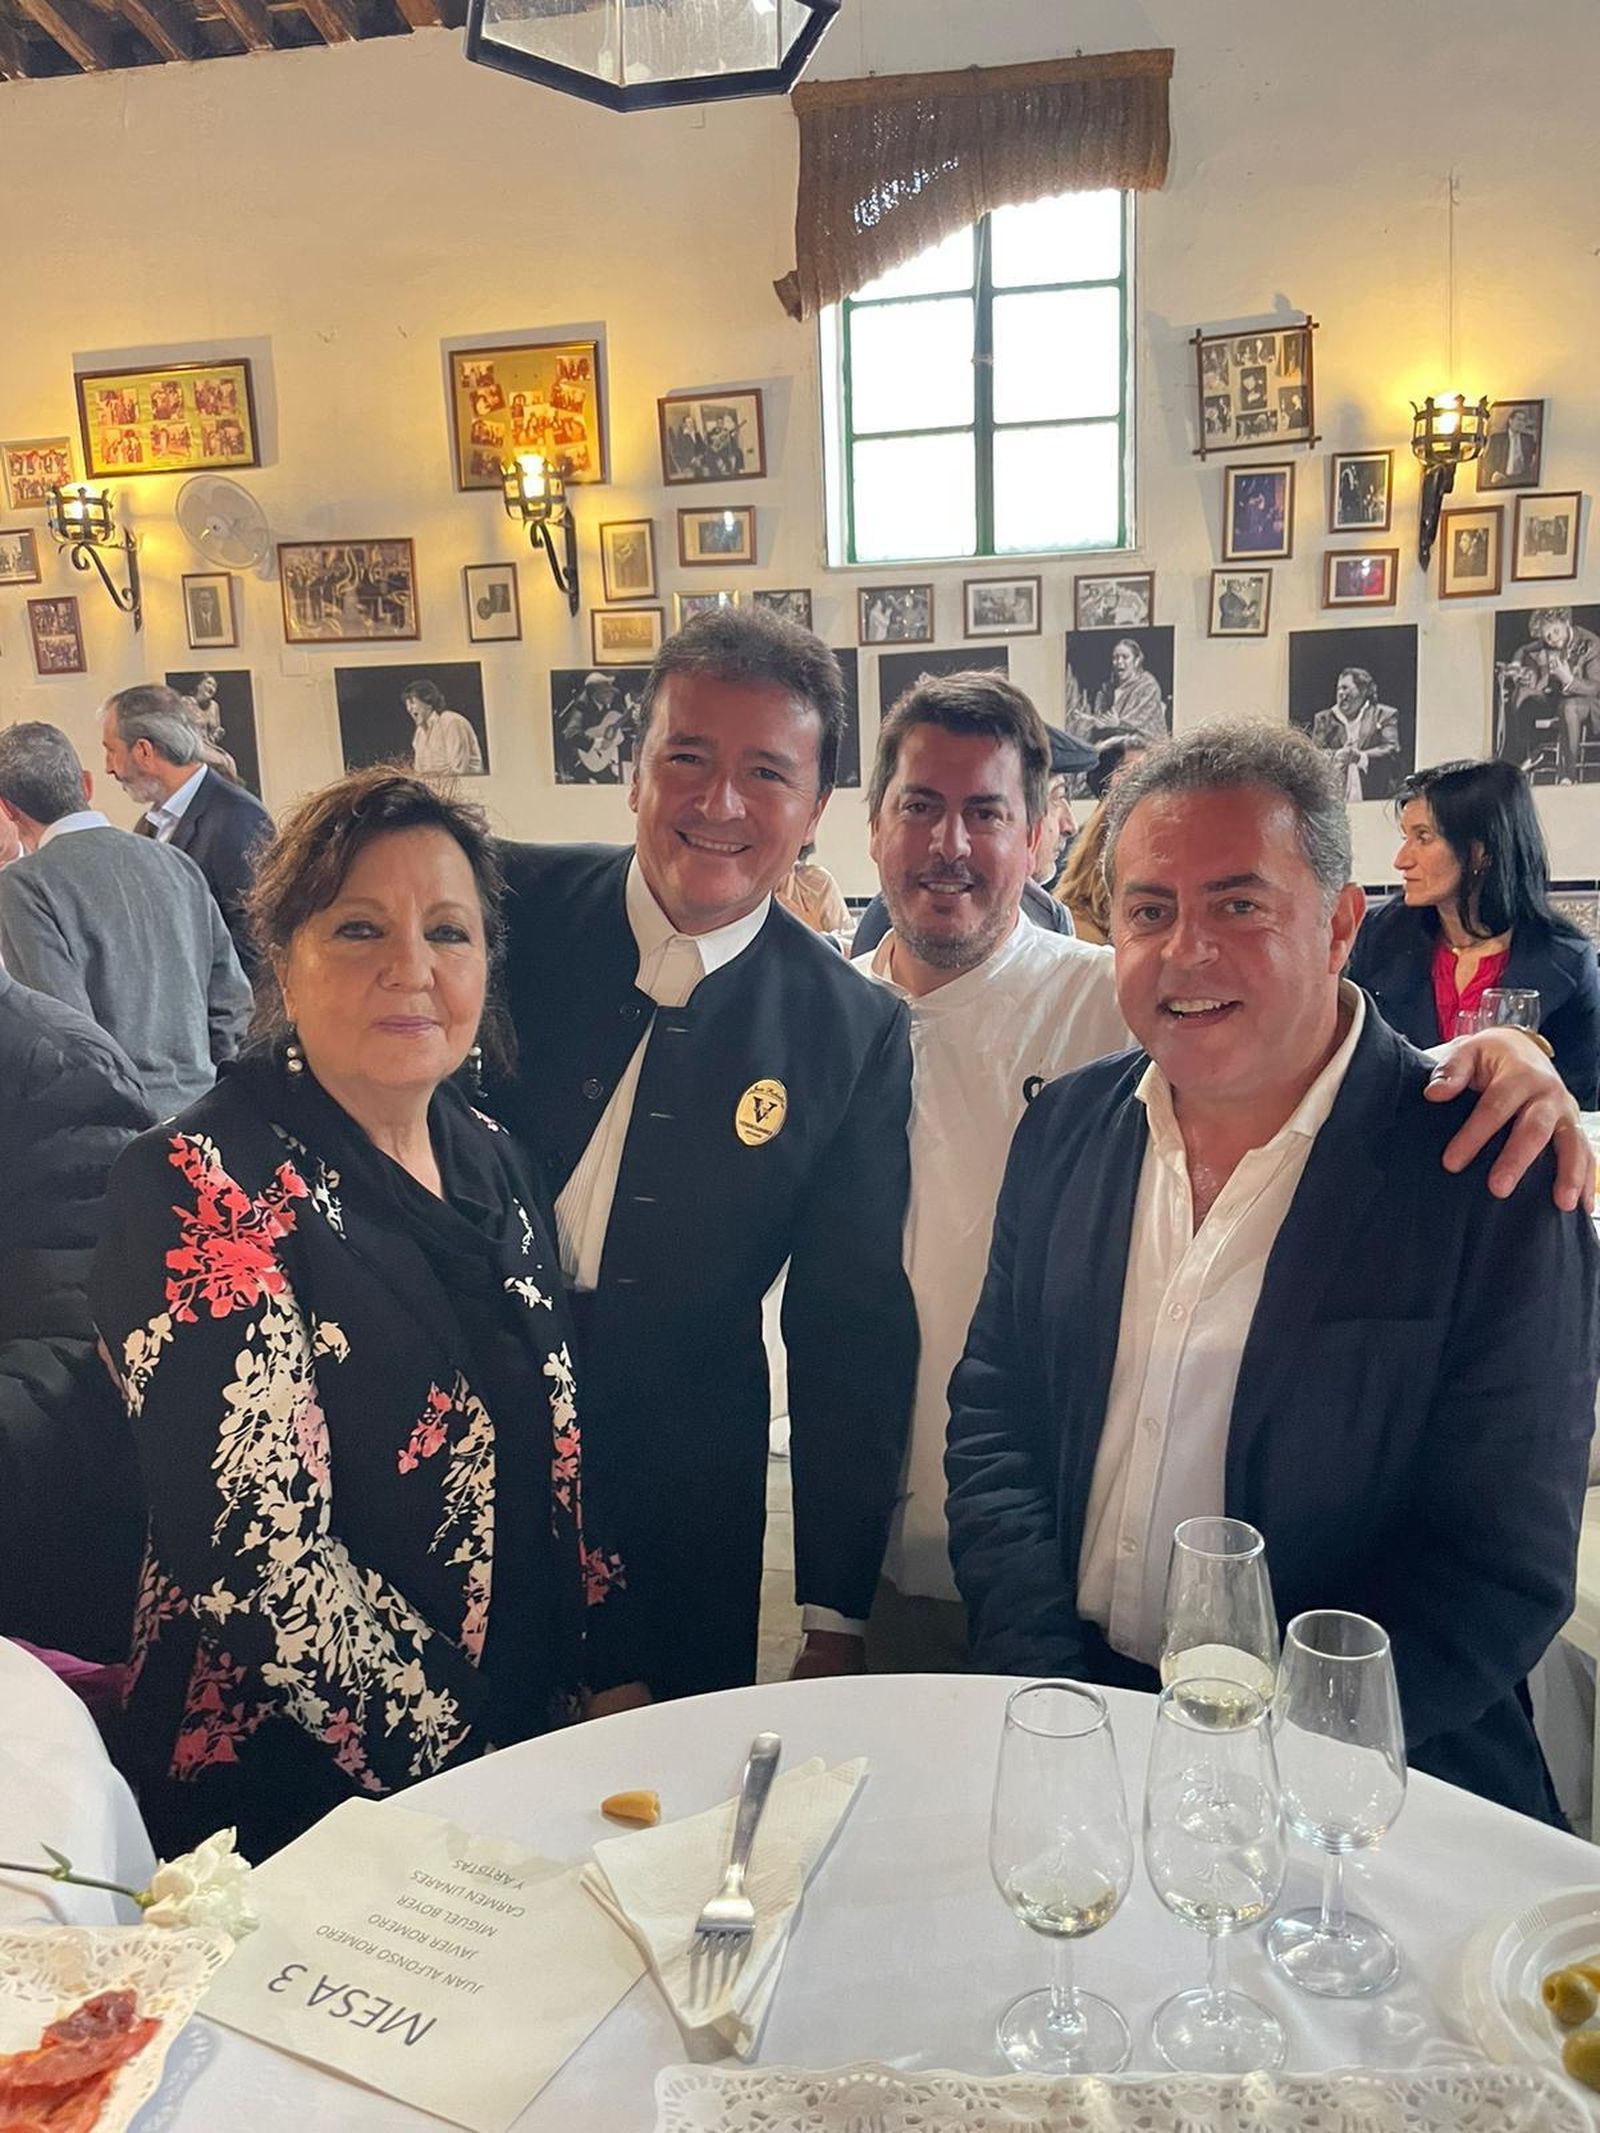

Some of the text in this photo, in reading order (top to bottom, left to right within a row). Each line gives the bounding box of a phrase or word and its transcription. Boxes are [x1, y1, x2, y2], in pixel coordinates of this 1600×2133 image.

[409, 1869, 526, 1918] CARMEN LINARES
[452, 1858, 525, 1891] Y ARTISTAS
[367, 1913, 480, 1961] JAVIER ROMERO
[396, 1894, 499, 1938] MIGUEL BOYER
[316, 1924, 485, 1995] JUAN ALFONSO ROMERO
[267, 1963, 438, 2047] MESA 3
